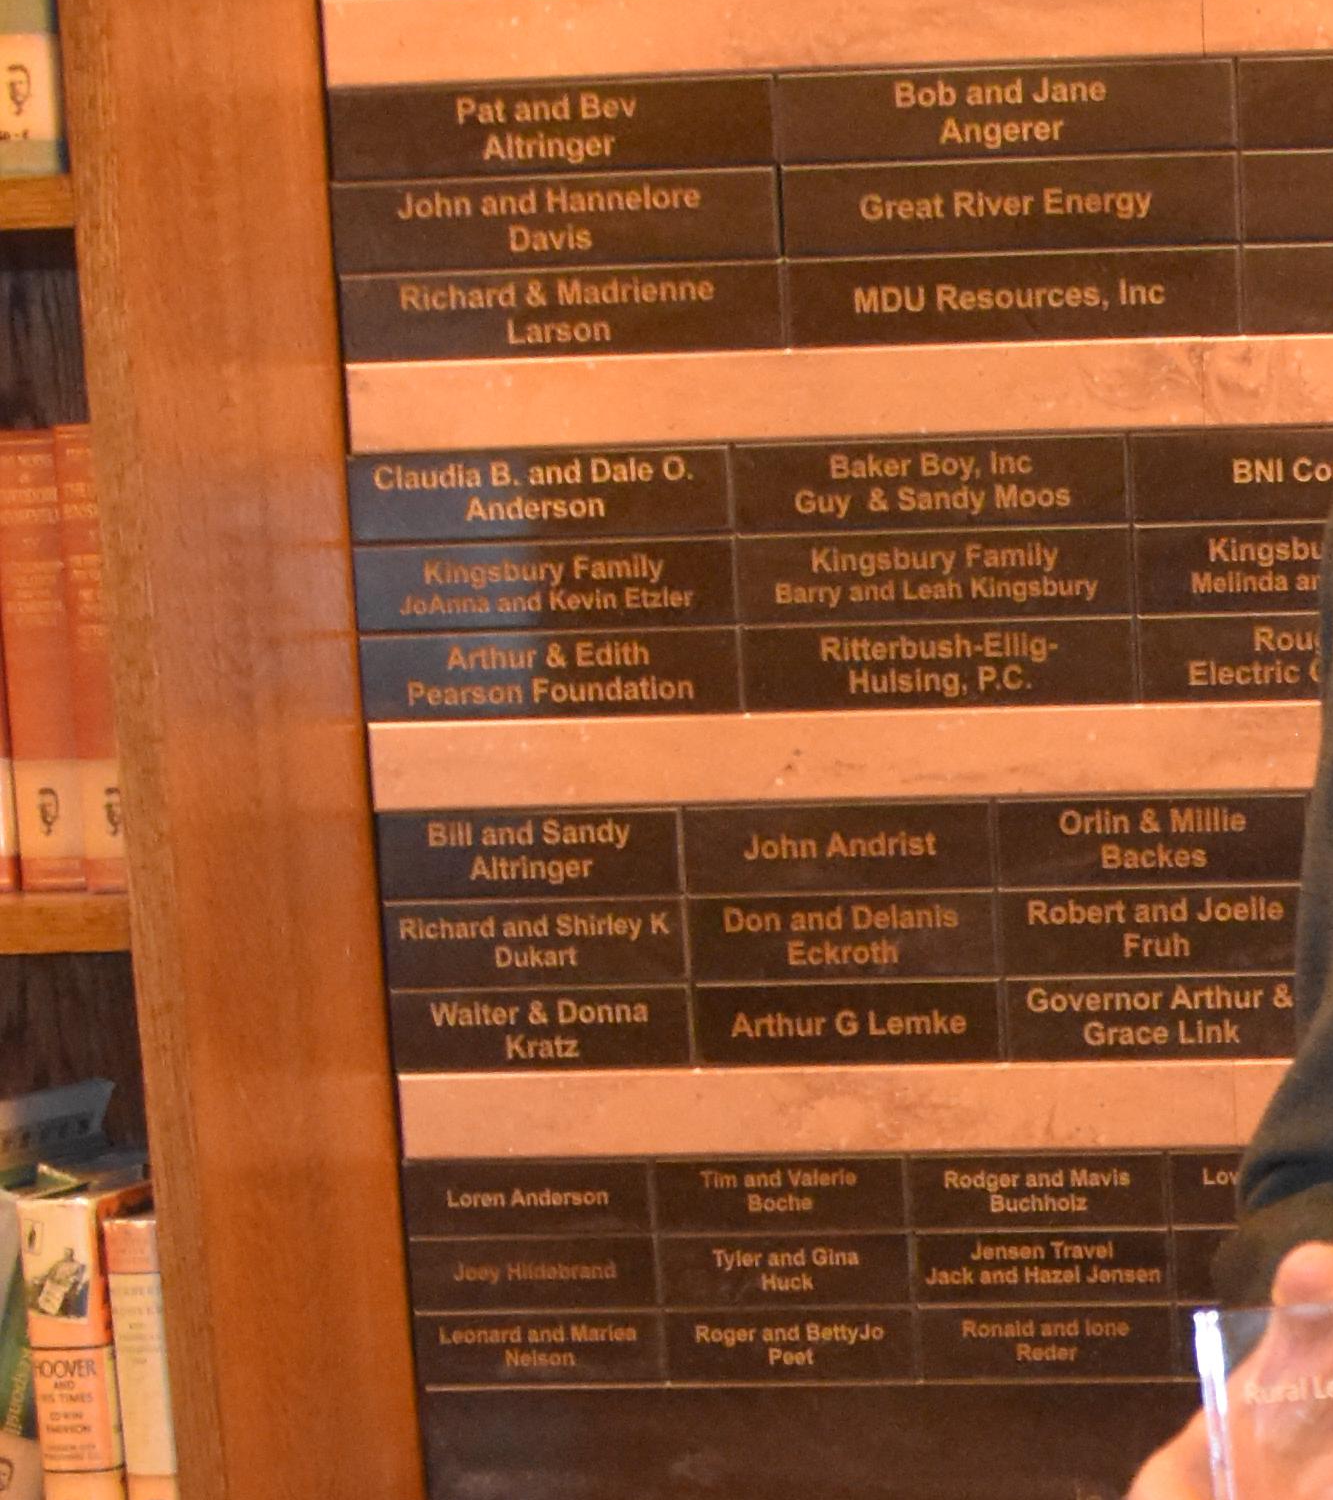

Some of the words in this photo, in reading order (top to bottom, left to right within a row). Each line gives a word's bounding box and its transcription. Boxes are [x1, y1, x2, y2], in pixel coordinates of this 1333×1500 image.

[859, 193, 945, 221] Great
[953, 190, 1035, 218] River
[1043, 187, 1152, 220] Energy
[853, 285, 925, 314] MDU
[936, 283, 1109, 312] Resources,
[1119, 278, 1165, 306] Inc
[829, 453, 912, 479] Baker
[920, 451, 981, 482] Boy,
[990, 450, 1033, 475] Inc
[794, 488, 852, 519] Guy
[867, 486, 890, 512] &
[897, 485, 986, 516] Sandy
[994, 483, 1071, 509] Moos
[1027, 899, 1126, 926] Robert
[1134, 897, 1189, 924] and
[1196, 895, 1284, 923] Joelle
[1123, 931, 1191, 959] Fruh
